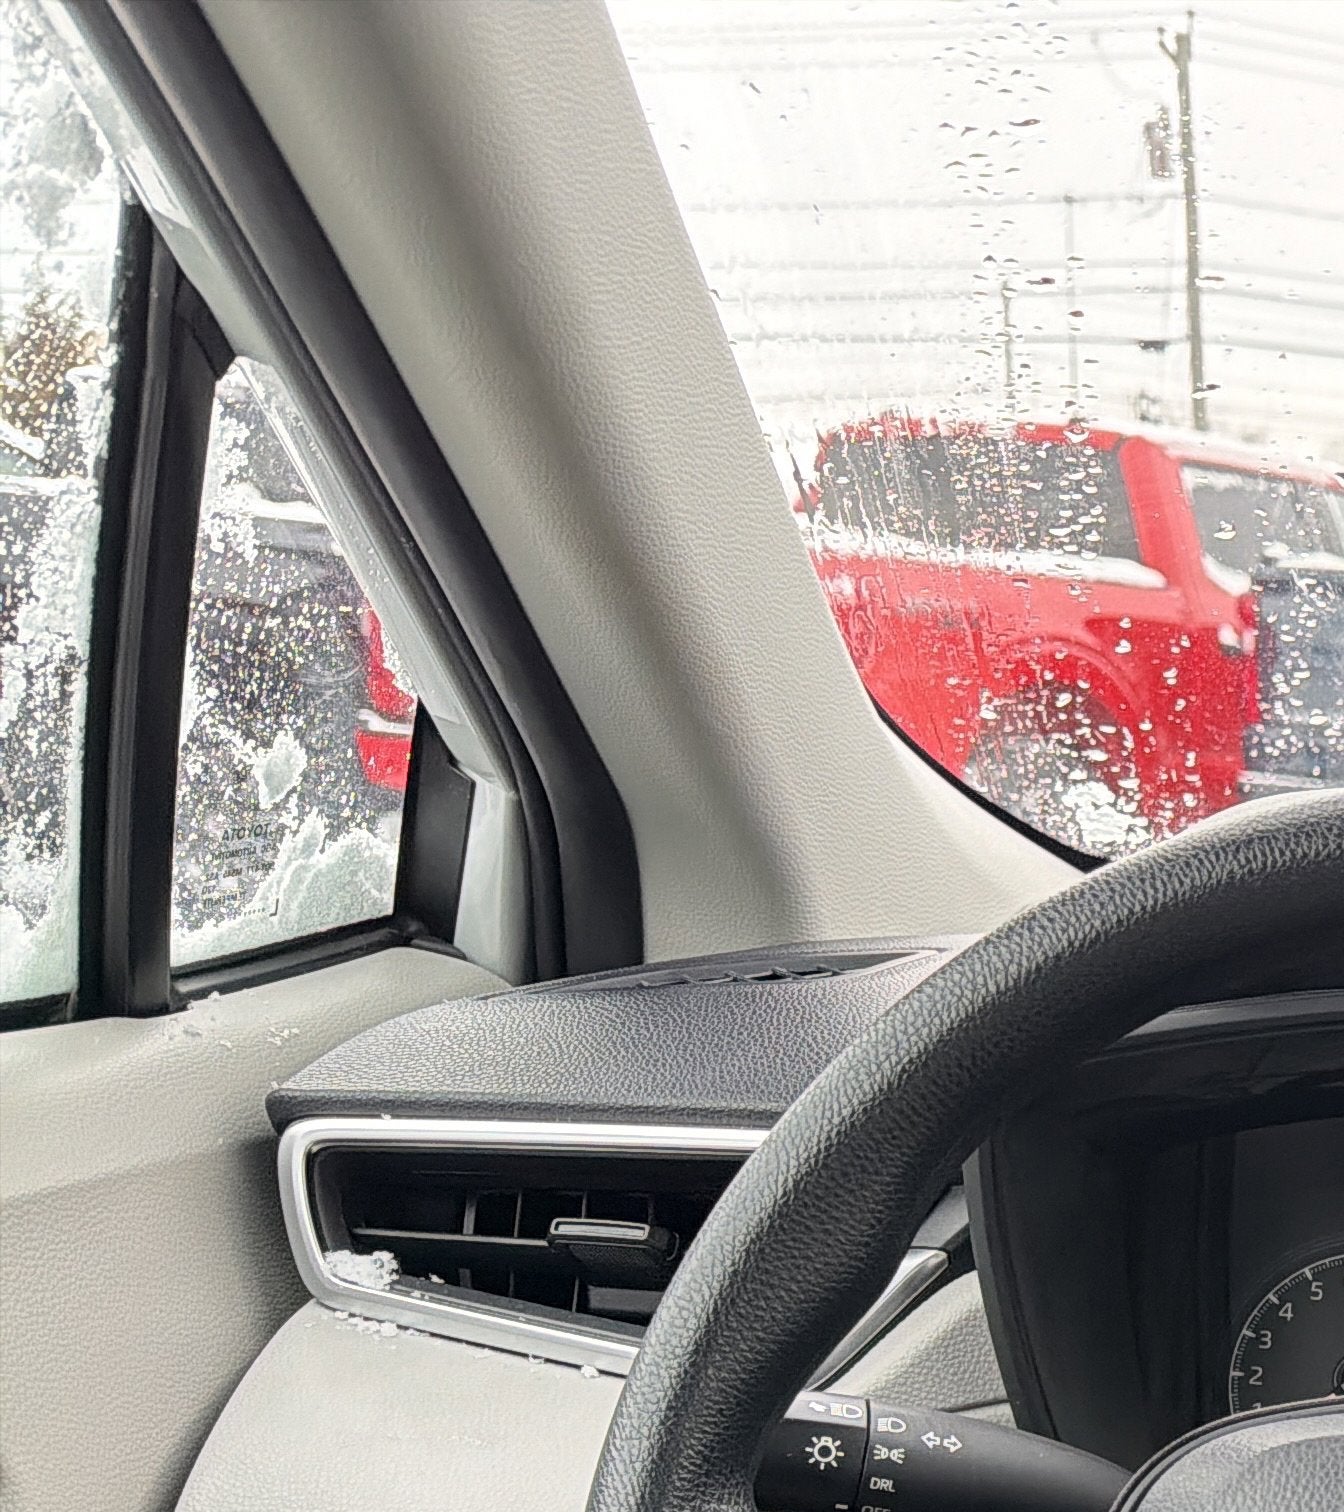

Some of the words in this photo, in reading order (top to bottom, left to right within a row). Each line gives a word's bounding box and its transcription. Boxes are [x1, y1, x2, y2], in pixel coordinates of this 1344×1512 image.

[1310, 1282, 1324, 1301] 5
[1278, 1302, 1294, 1322] 4
[1258, 1330, 1273, 1350] 3
[1249, 1366, 1263, 1386] 2
[869, 1476, 896, 1493] DRL
